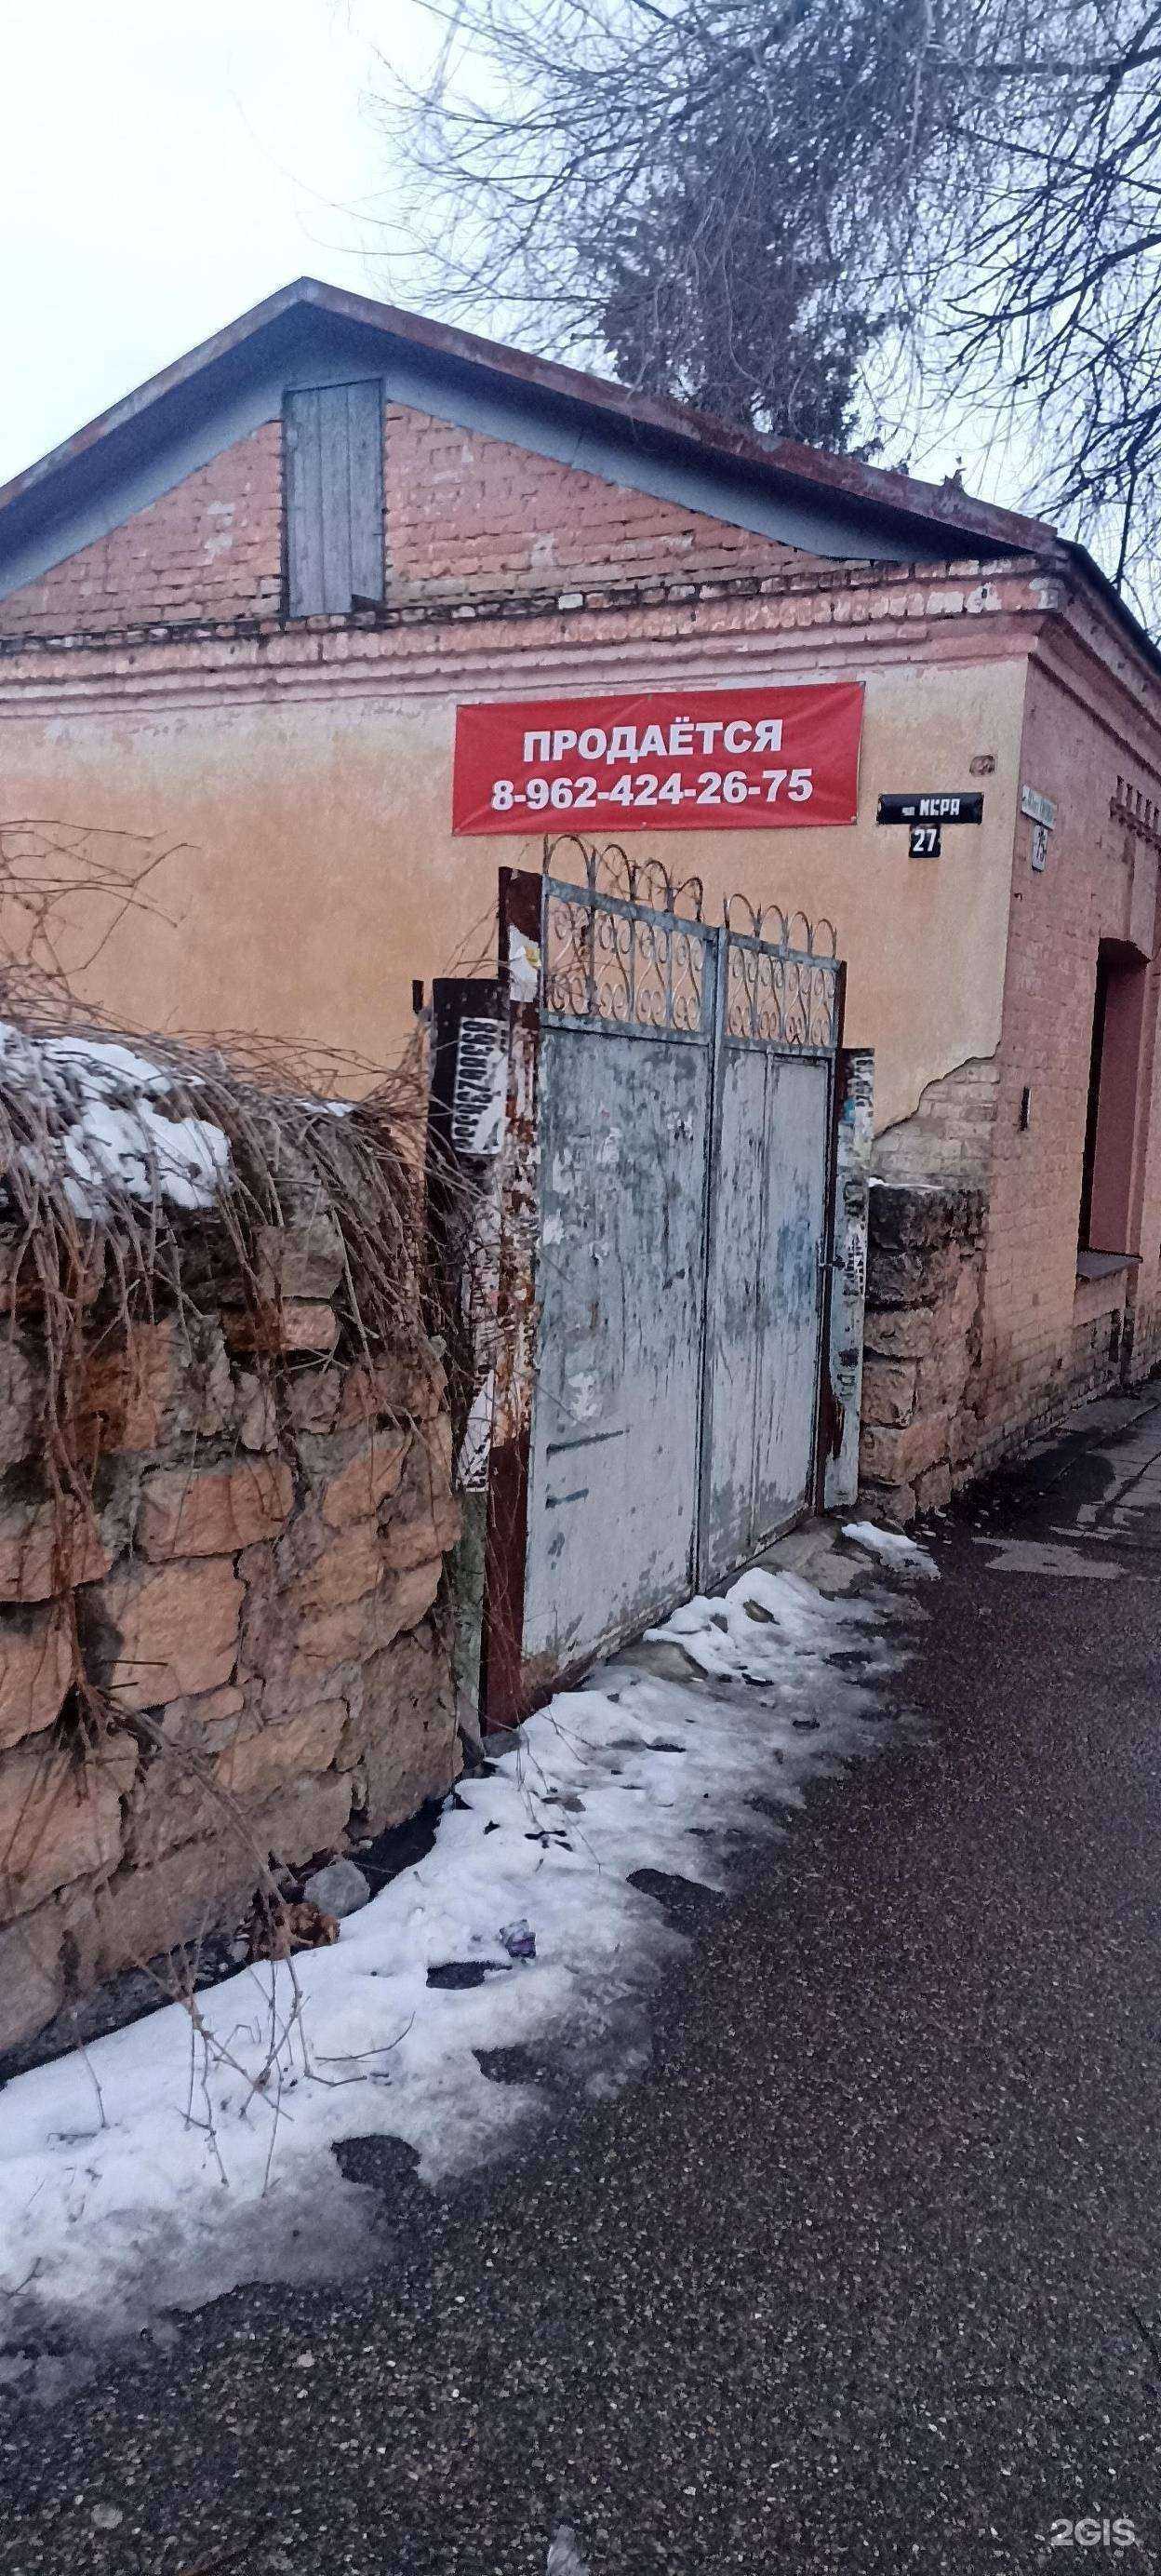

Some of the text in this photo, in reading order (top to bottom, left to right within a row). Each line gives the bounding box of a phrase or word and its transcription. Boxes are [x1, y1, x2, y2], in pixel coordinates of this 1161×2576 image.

[523, 716, 783, 765] ПРОДАЁТСЯ
[491, 768, 814, 812] 8-962-424-26-75
[913, 828, 938, 852] 27
